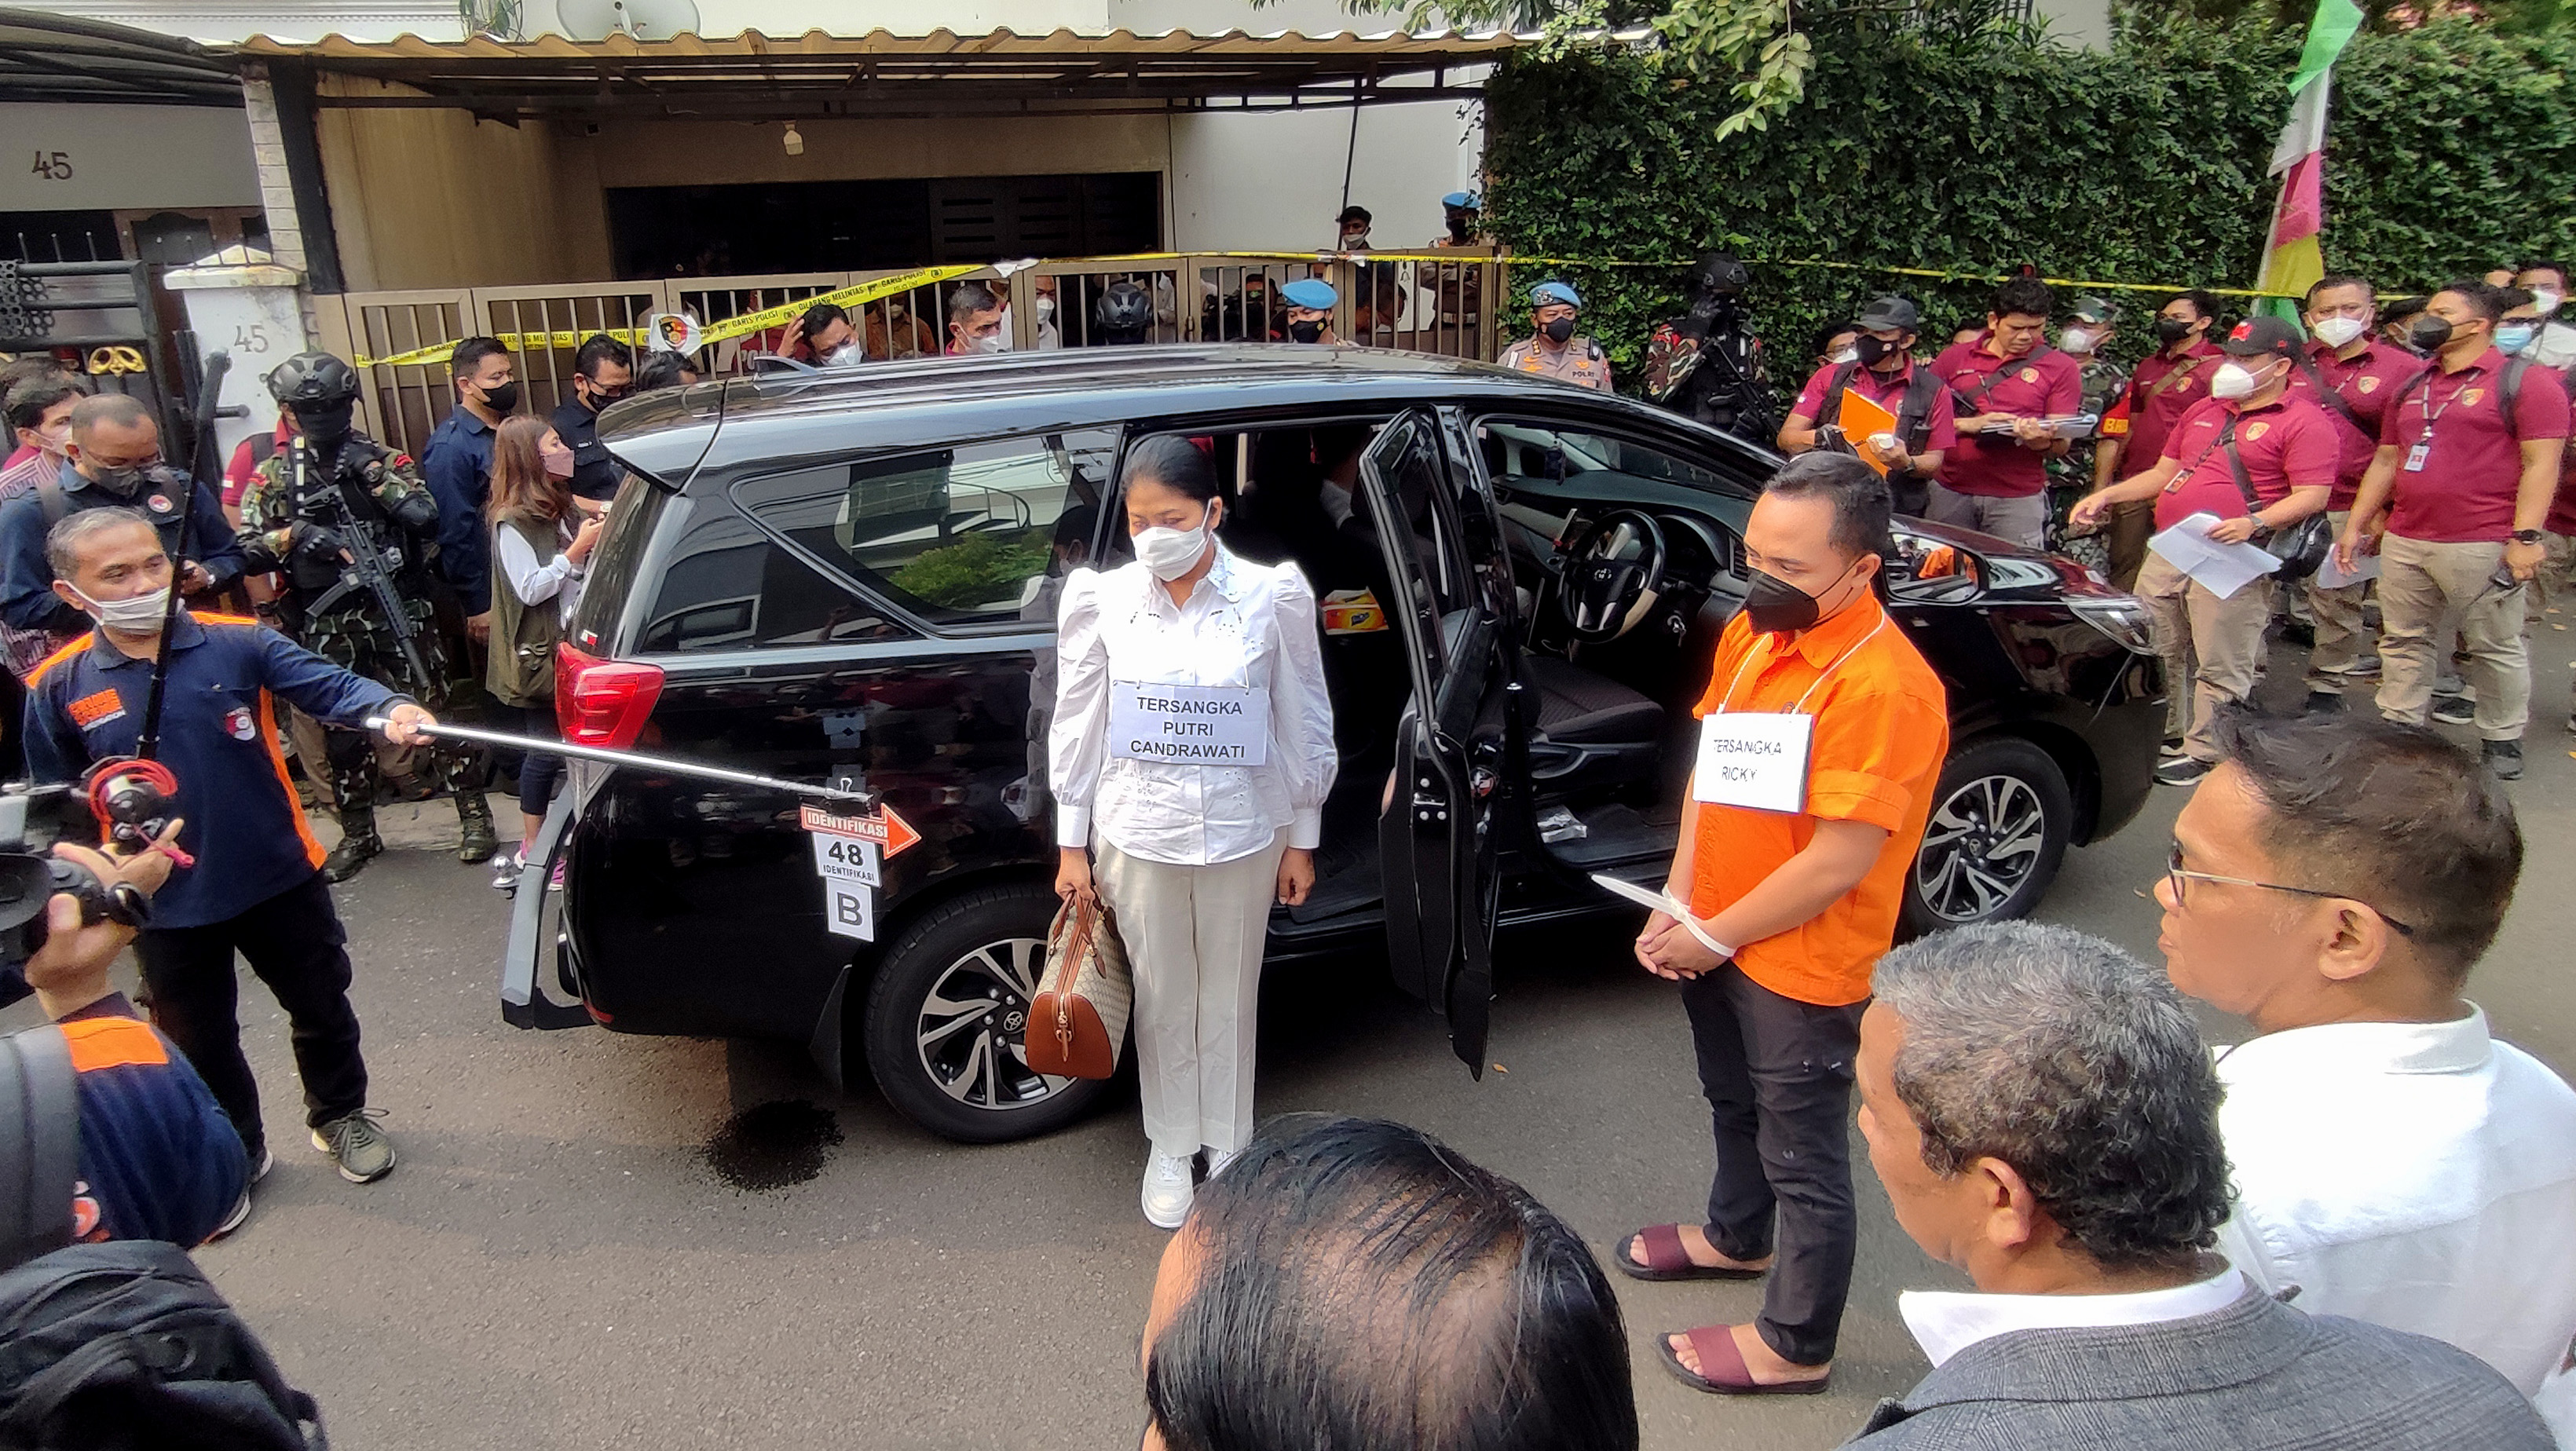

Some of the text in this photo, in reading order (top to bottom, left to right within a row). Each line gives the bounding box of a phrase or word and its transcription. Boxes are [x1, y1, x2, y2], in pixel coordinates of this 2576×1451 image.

[32, 151, 72, 180] 45
[880, 273, 902, 287] GARIS
[832, 287, 864, 302] MELINTAS
[731, 309, 779, 328] GARIS POLISI
[234, 324, 269, 353] 45
[1136, 696, 1243, 715] TERSANGKA
[1163, 721, 1214, 736] PUTRI
[1130, 740, 1246, 758] CANDRAWATI
[1714, 739, 1782, 755] TERSANGKA
[1722, 766, 1758, 782] RICKY
[807, 811, 888, 839] IDENTIFIKASI
[828, 841, 864, 866] 48
[822, 864, 875, 882] IDENTIFIKASI
[836, 891, 863, 927] B
